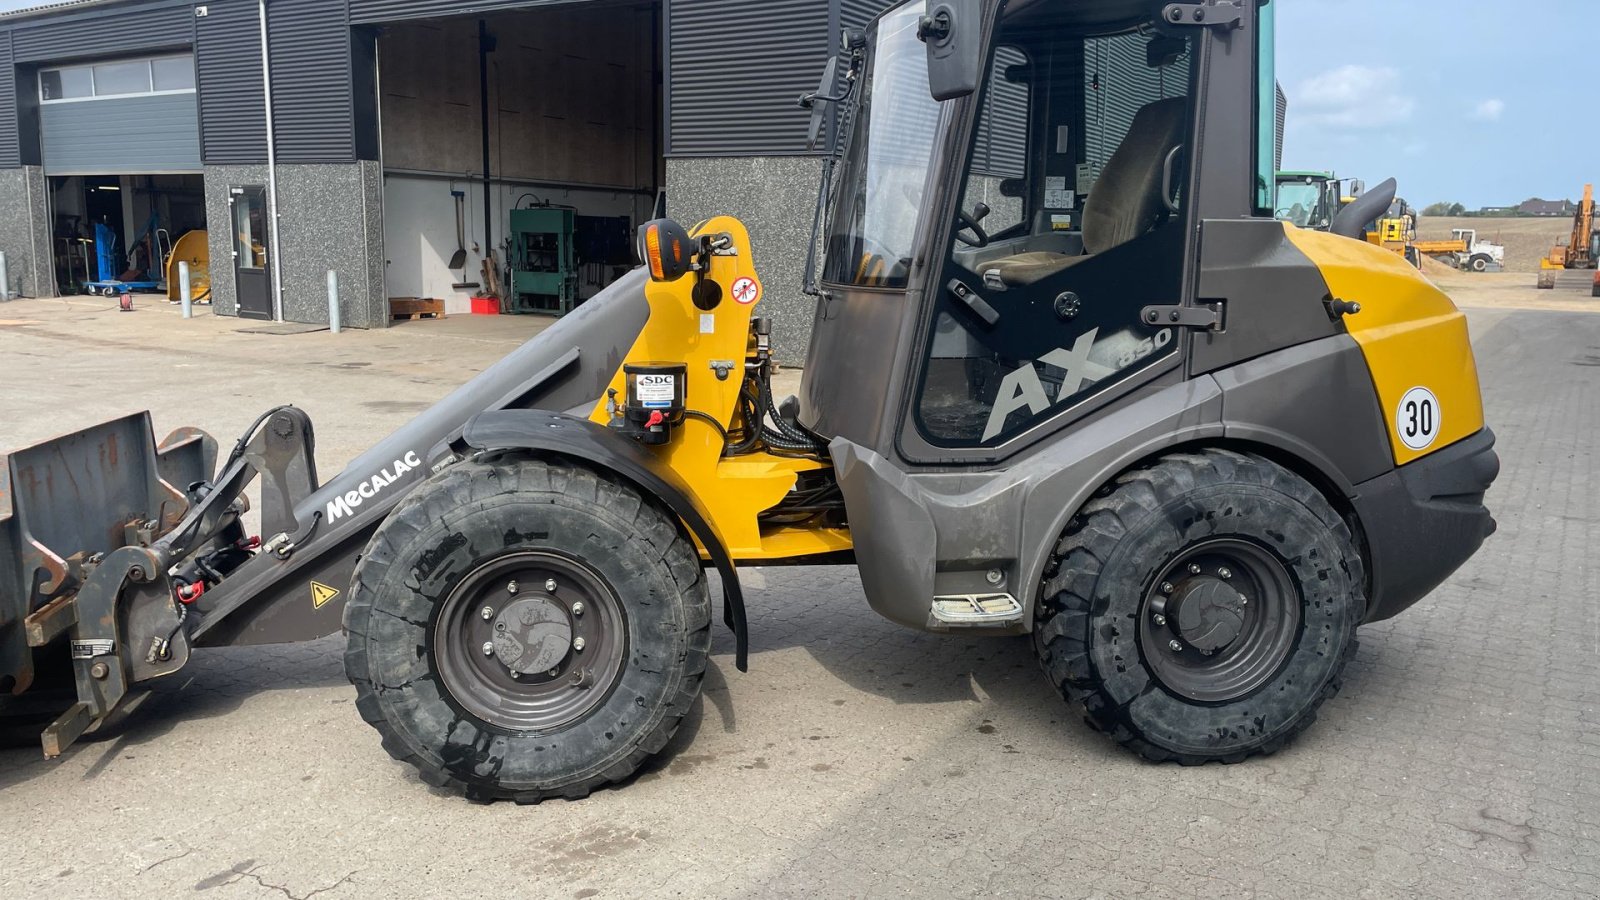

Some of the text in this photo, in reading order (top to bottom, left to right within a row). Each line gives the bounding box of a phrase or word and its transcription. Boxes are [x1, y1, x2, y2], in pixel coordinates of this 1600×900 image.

[644, 375, 673, 384] SDC
[980, 326, 1117, 443] AX
[1405, 399, 1432, 438] 30
